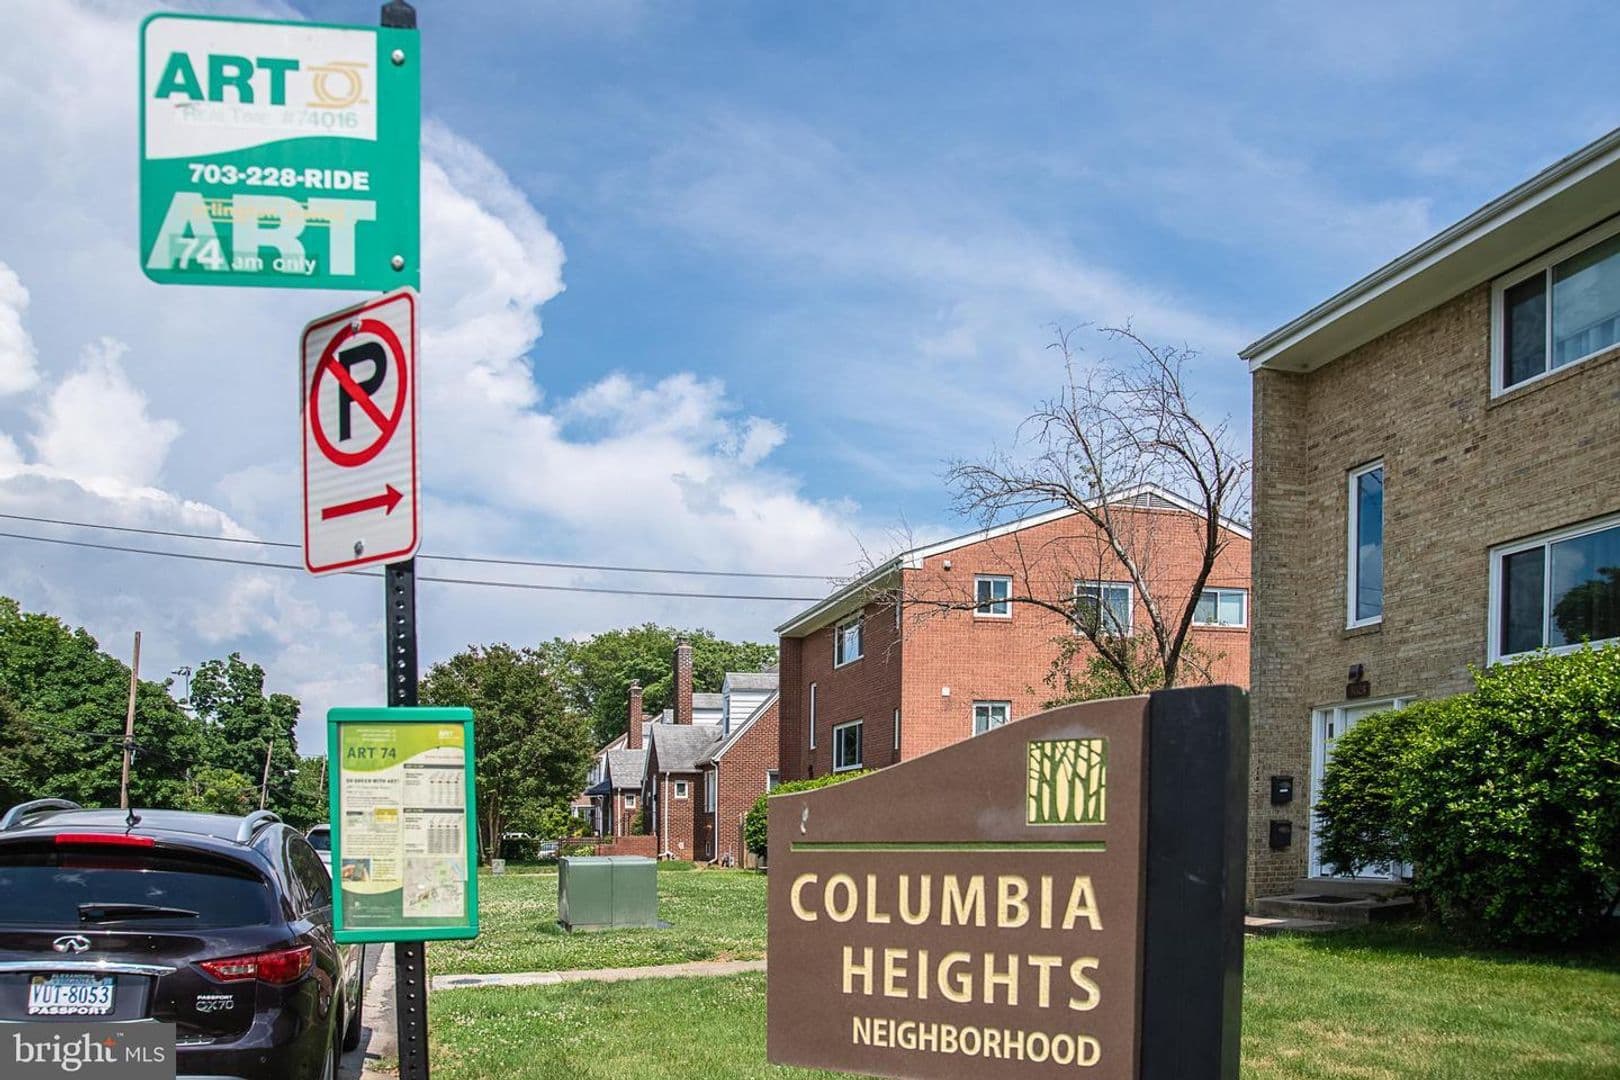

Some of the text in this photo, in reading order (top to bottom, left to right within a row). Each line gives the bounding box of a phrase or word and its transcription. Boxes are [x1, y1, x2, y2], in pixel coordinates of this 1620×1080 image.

[154, 51, 300, 106] ART
[188, 163, 370, 190] 703-228-RIDE
[146, 191, 377, 276] ART
[175, 237, 224, 270] 74
[338, 341, 387, 442] P
[347, 747, 397, 759] ART 74
[790, 873, 1104, 931] COLUMBIA
[842, 946, 1102, 1012] HEIGHTS
[28, 1006, 109, 1015] PASSPORT
[195, 1000, 234, 1012] QX70
[852, 1016, 1101, 1067] NEIGHBORHOOD
